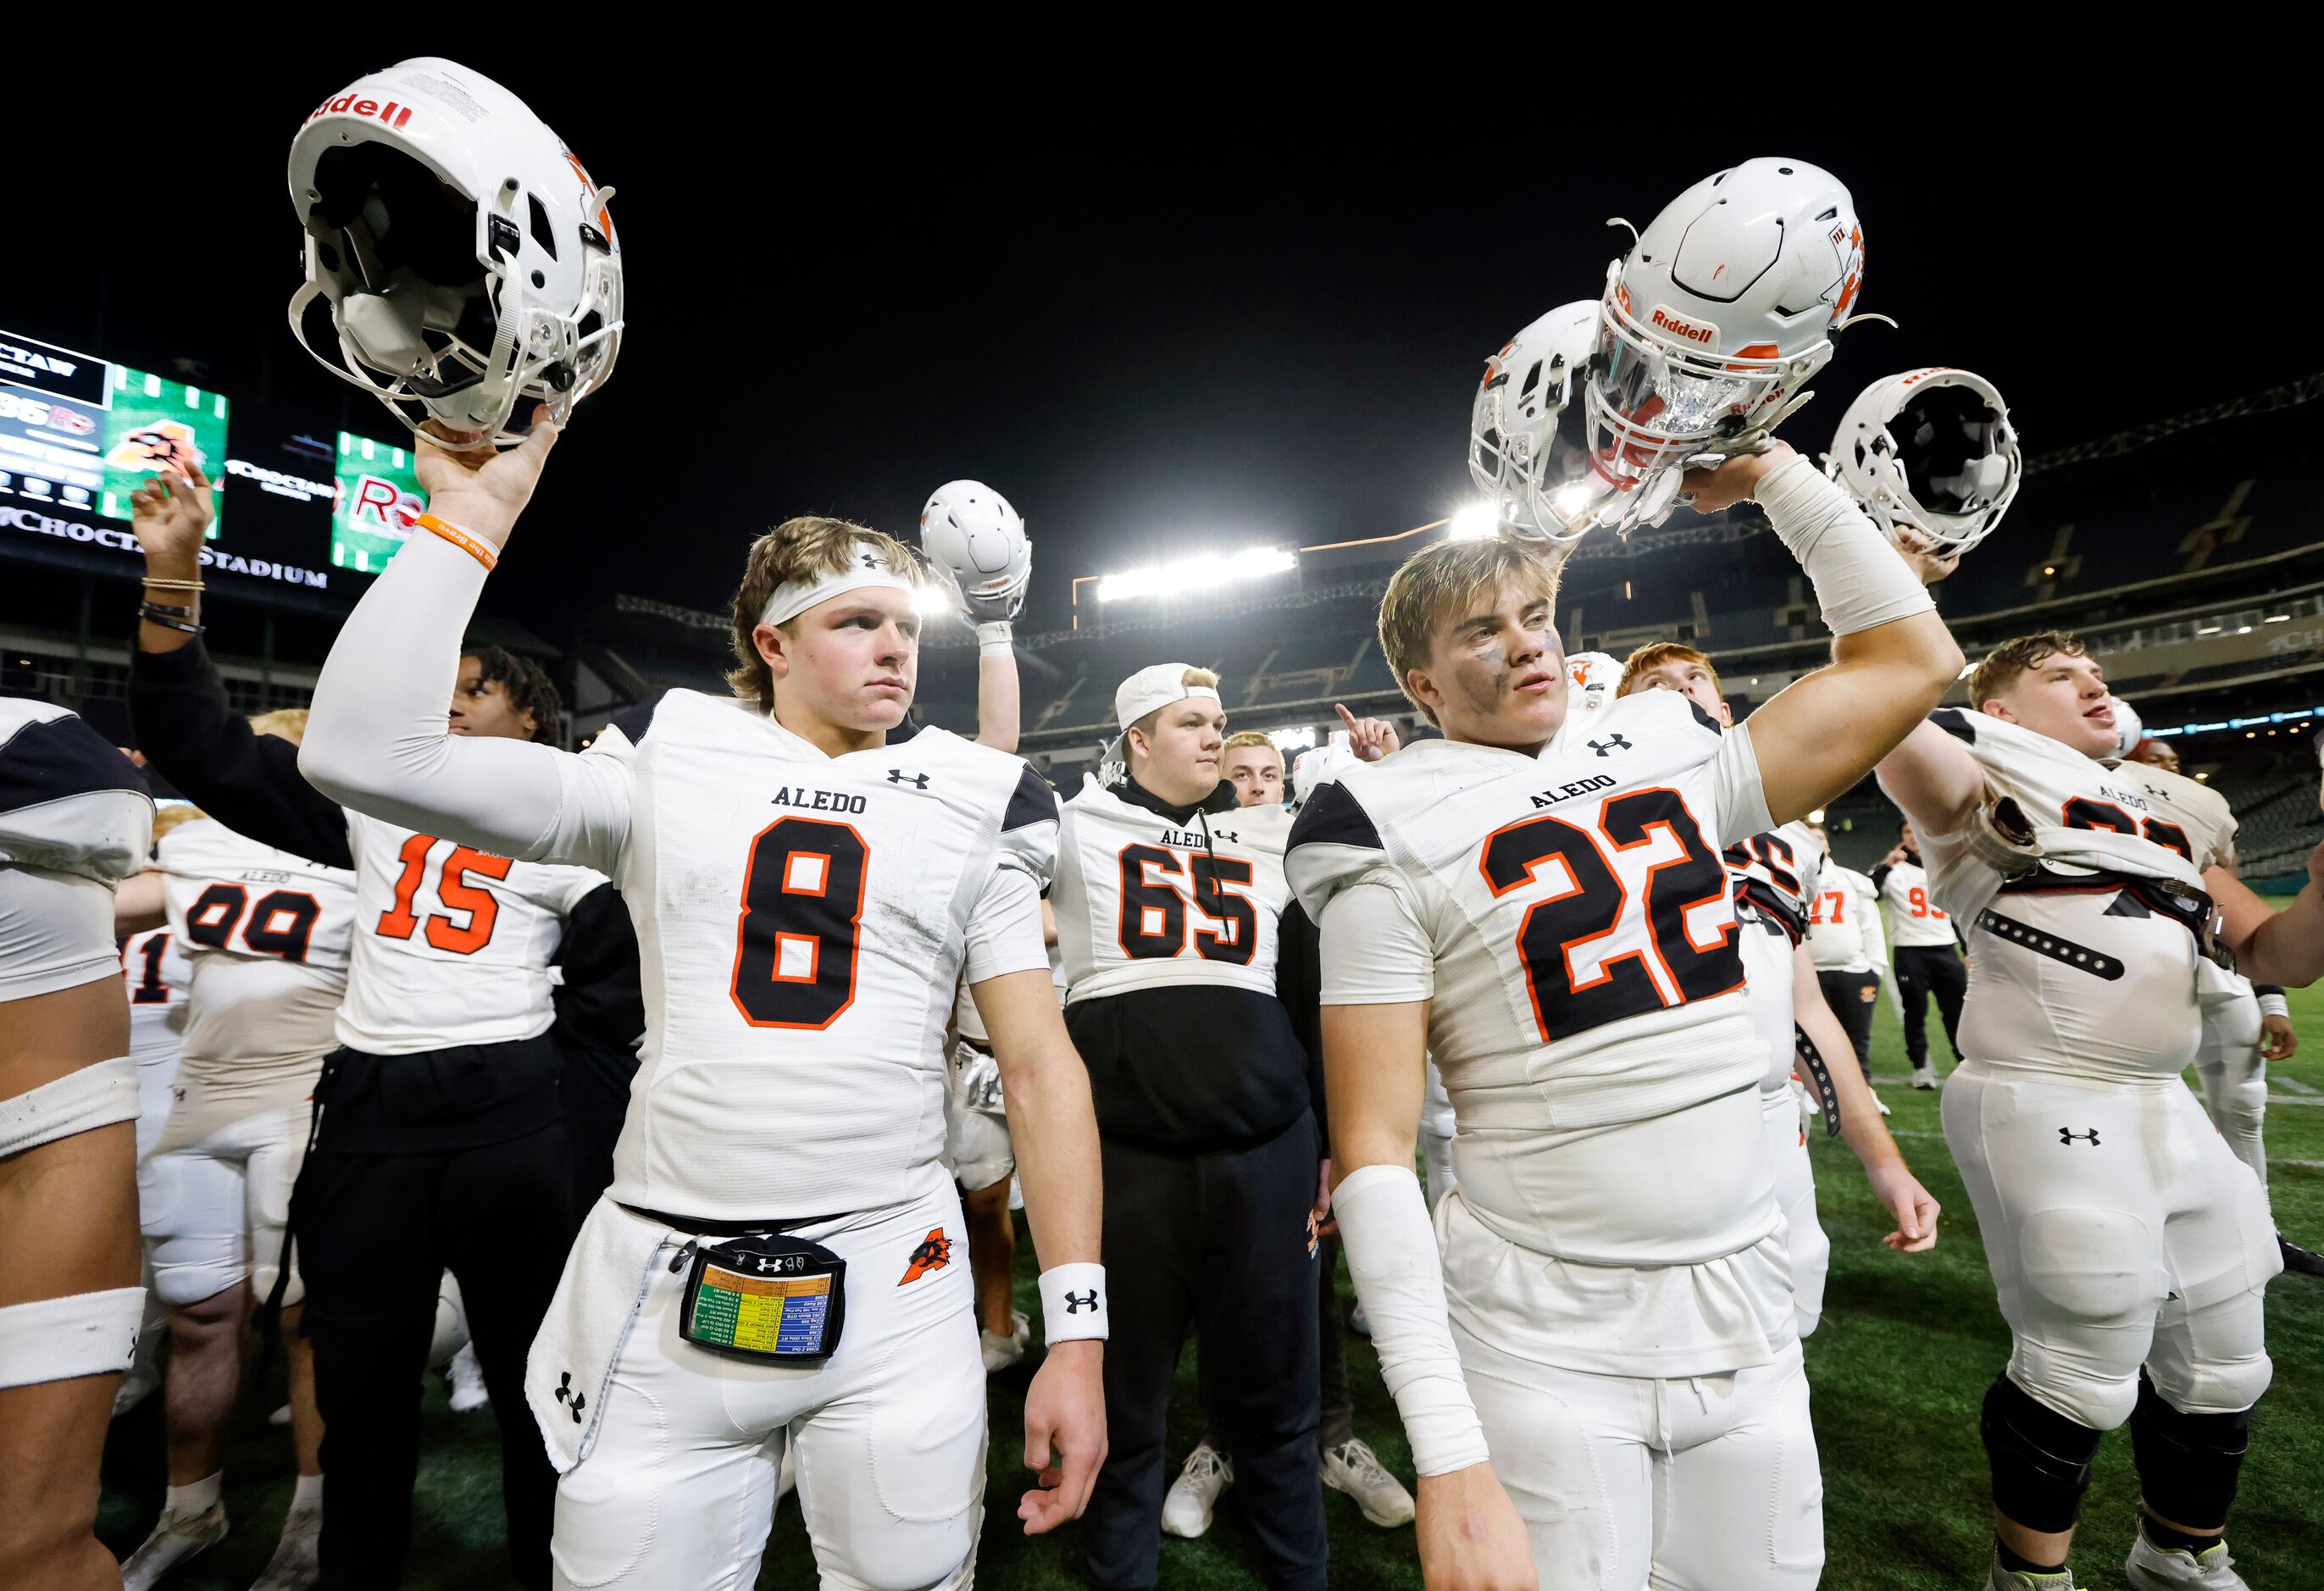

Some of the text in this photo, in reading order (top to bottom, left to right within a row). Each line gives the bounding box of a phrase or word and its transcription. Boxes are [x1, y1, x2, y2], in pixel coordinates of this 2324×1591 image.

[306, 93, 413, 129] ddell
[1652, 309, 1713, 343] Riddell
[10, 508, 328, 589] CHOCT STADIUM
[437, 524, 469, 546] Brave
[770, 786, 868, 815] ALEDO
[1529, 773, 1617, 809] ALEDO
[2099, 785, 2148, 812] ALEDO
[1160, 829, 1212, 849] ALED
[375, 834, 515, 956] 15
[1118, 842, 1257, 967] 65
[1478, 786, 1747, 1043] 22
[186, 883, 321, 962] 99
[729, 815, 871, 1031] 8
[120, 933, 171, 1005] 1
